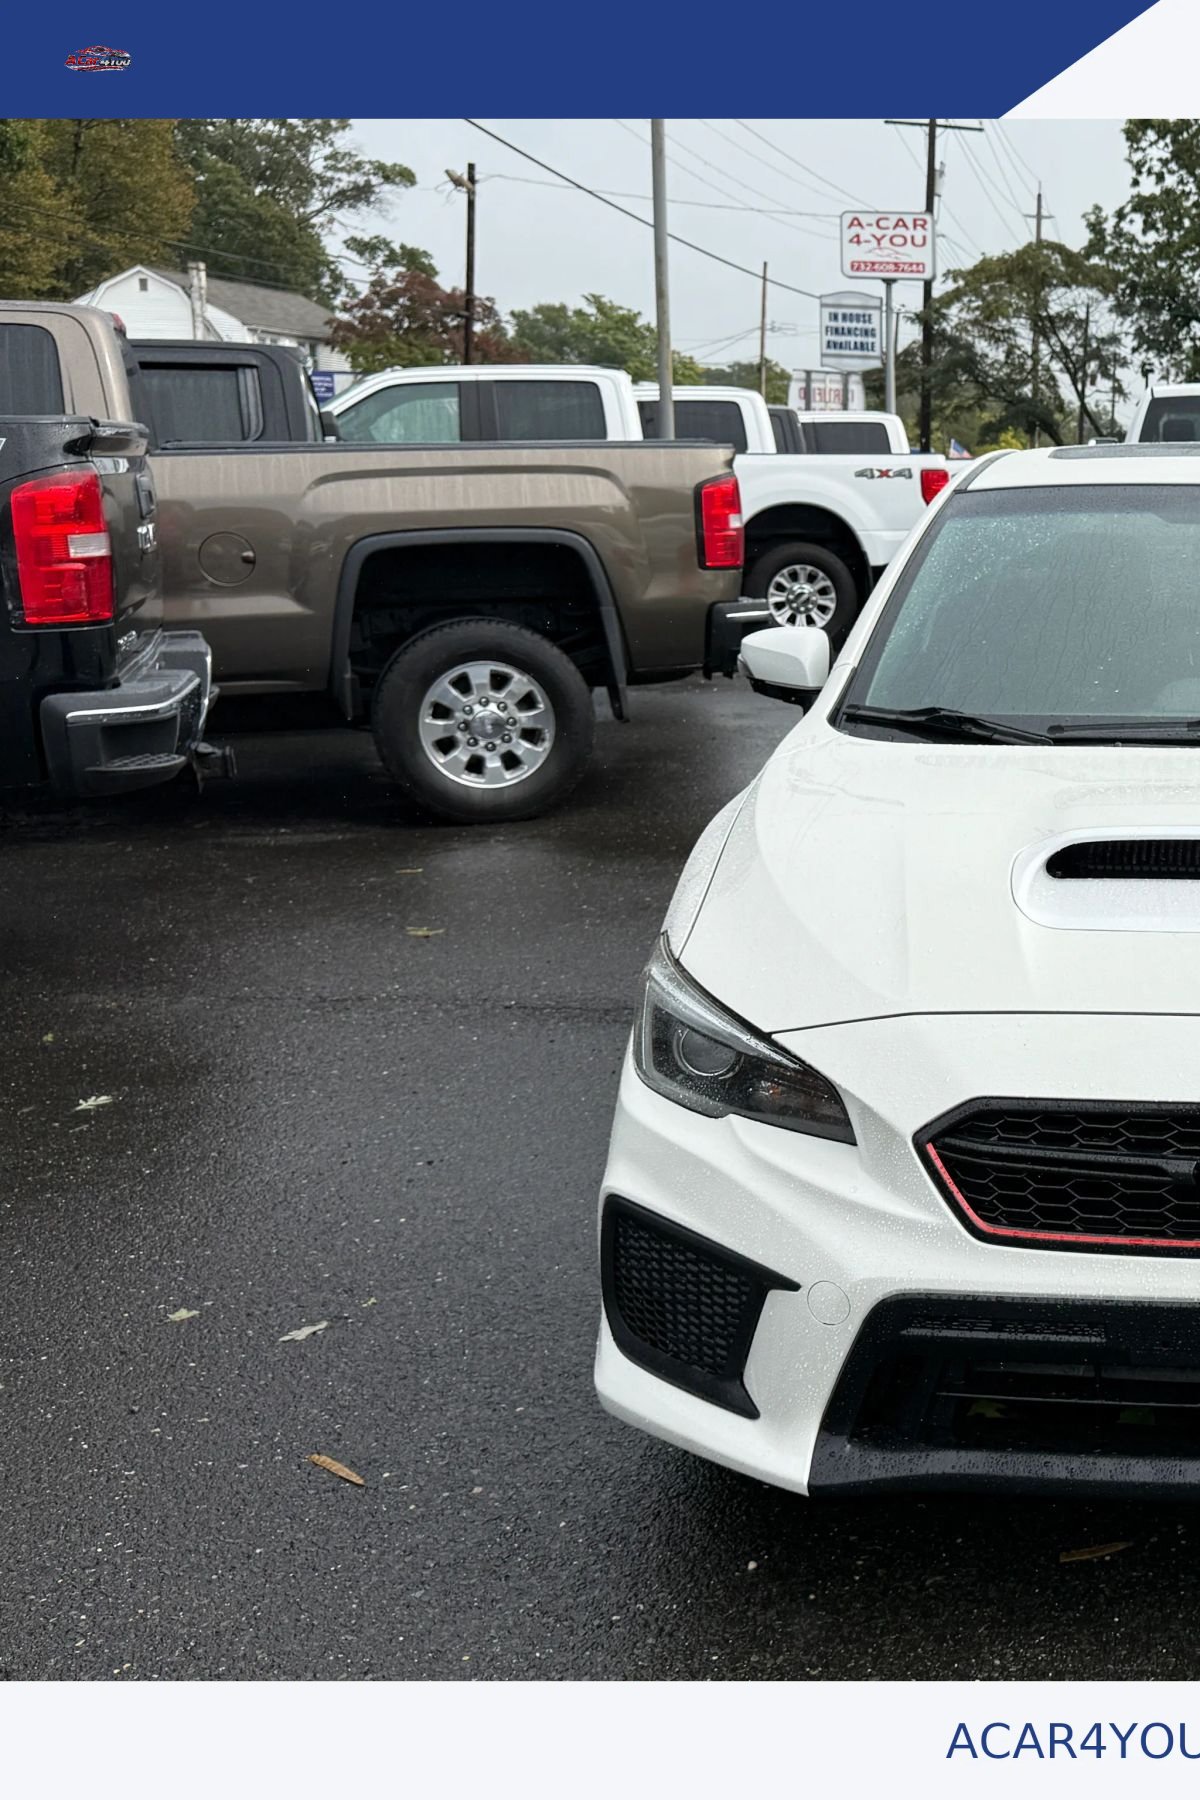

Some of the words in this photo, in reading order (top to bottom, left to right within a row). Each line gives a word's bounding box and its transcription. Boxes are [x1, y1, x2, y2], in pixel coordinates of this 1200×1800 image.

[847, 216, 928, 231] A-CAR
[848, 233, 927, 248] 4-YOU
[829, 312, 839, 323] IN
[841, 312, 873, 325] HOUSE
[825, 325, 877, 339] FINANCING
[826, 340, 876, 353] AVAILABLE
